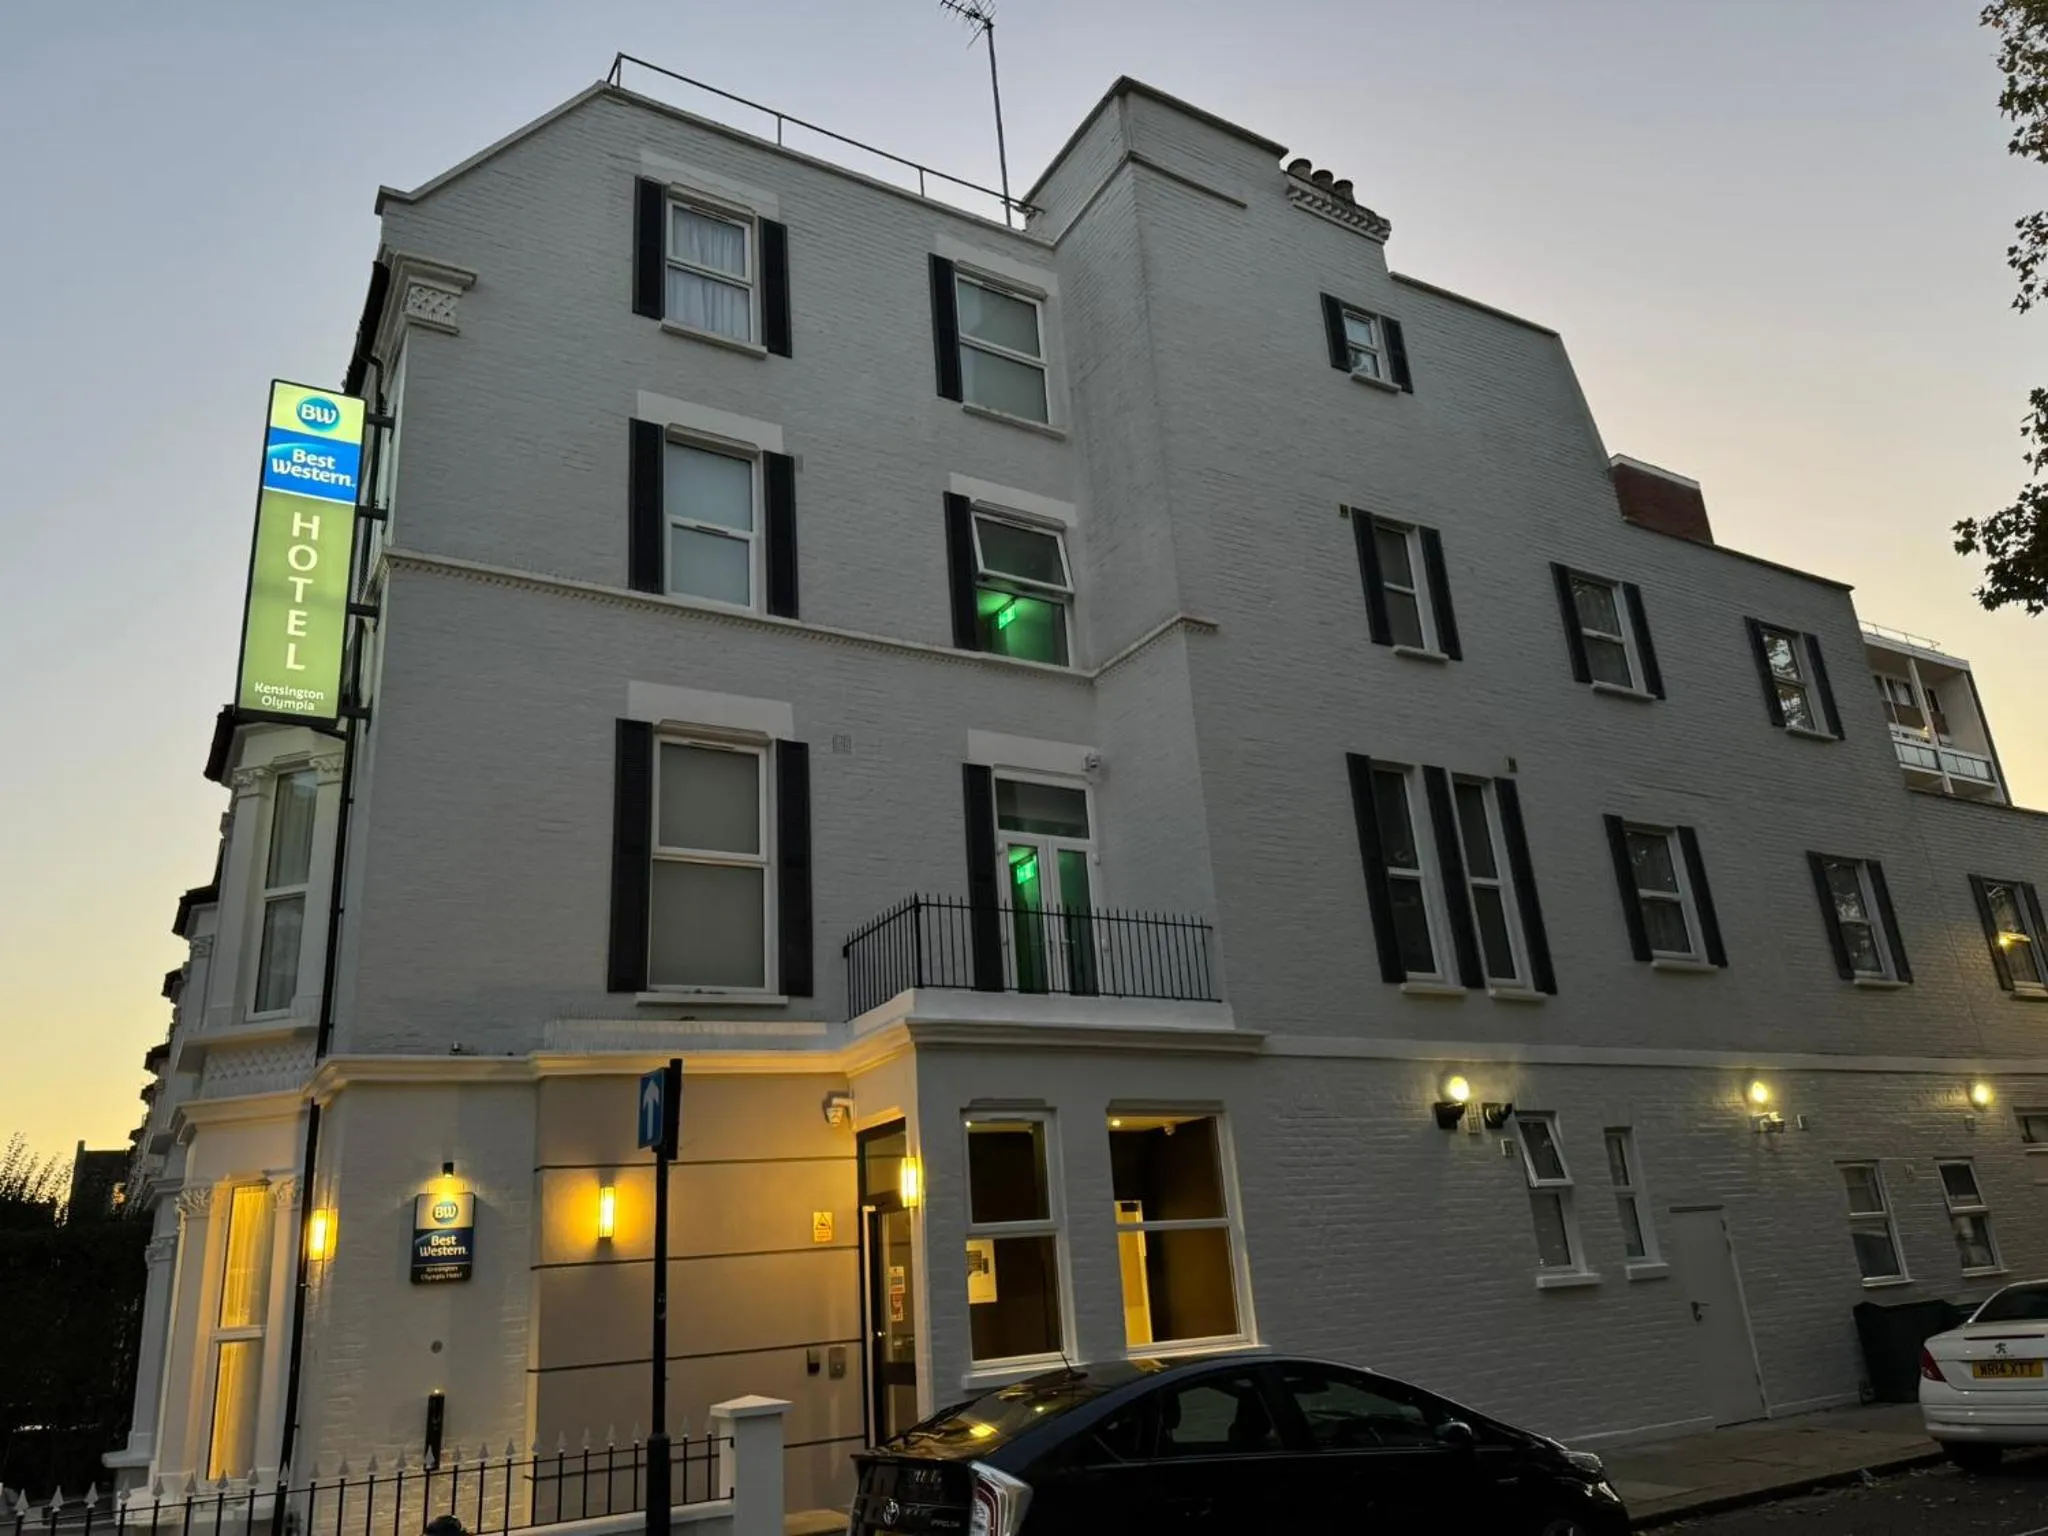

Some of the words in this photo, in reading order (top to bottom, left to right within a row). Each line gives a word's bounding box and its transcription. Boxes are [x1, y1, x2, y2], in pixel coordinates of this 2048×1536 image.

[301, 403, 337, 425] BW
[292, 448, 336, 470] Best
[286, 511, 321, 671] HOTEL
[254, 681, 324, 701] Kensington
[261, 695, 315, 711] Olympia
[435, 1205, 457, 1219] BW
[431, 1234, 457, 1247] Best
